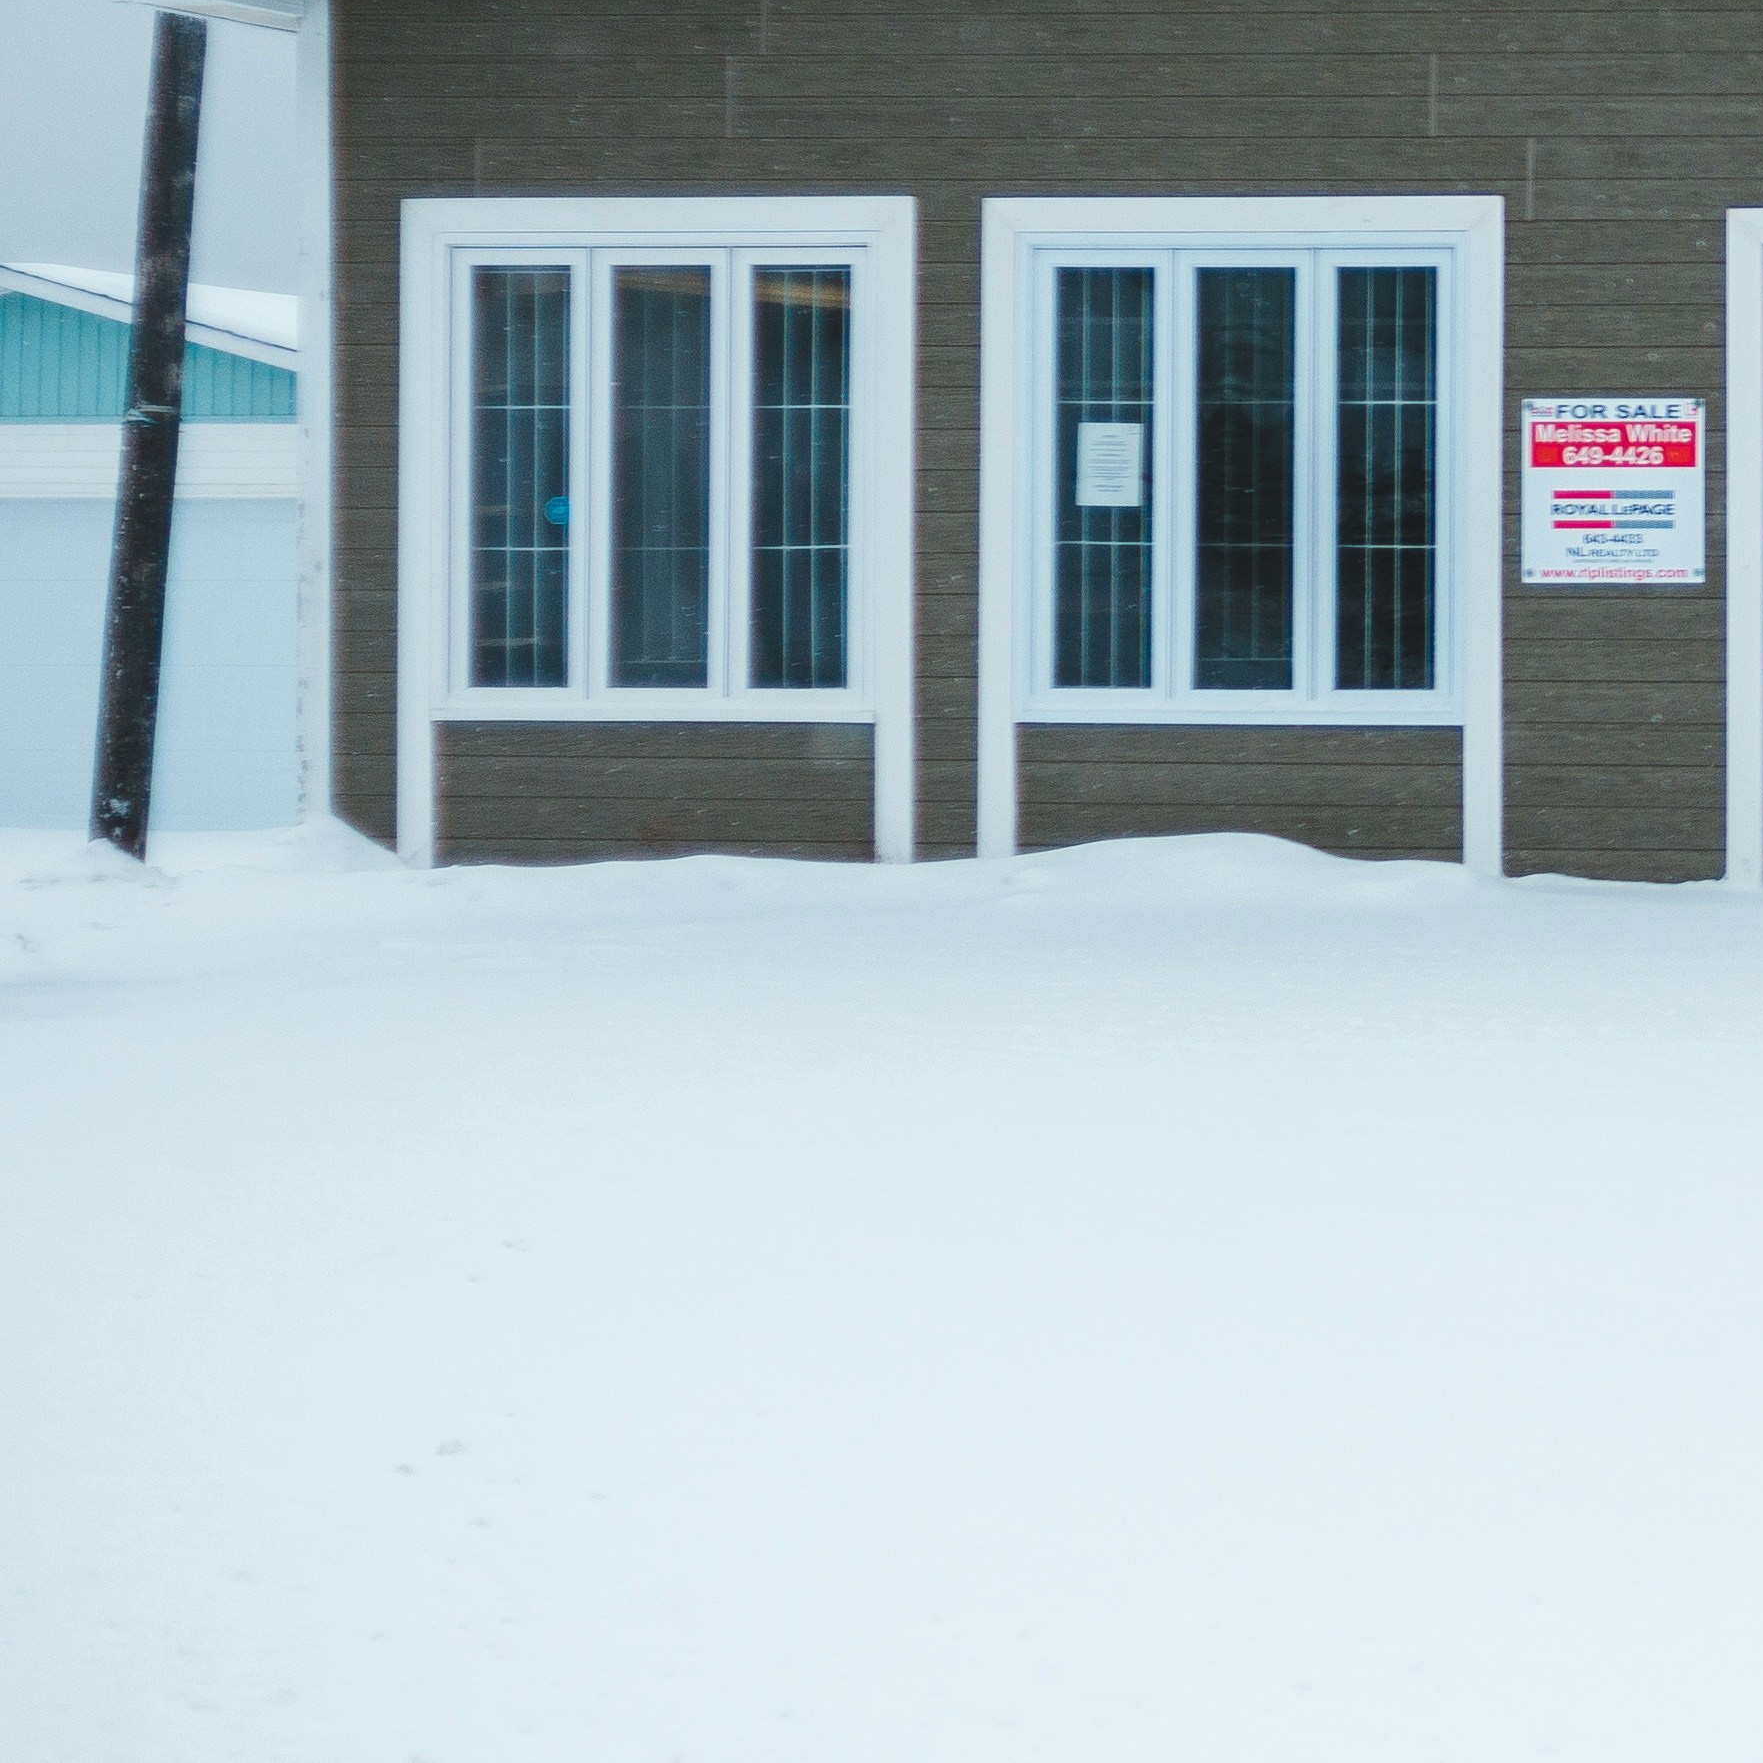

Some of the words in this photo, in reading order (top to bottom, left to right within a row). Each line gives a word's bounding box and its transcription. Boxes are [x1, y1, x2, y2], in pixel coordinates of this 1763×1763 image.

[1555, 404, 1607, 419] FOR
[1616, 404, 1681, 419] SALE
[1534, 424, 1621, 443] Melissa
[1625, 424, 1692, 443] White
[1562, 446, 1664, 465] 649-4426
[1552, 503, 1610, 515] ROYAL
